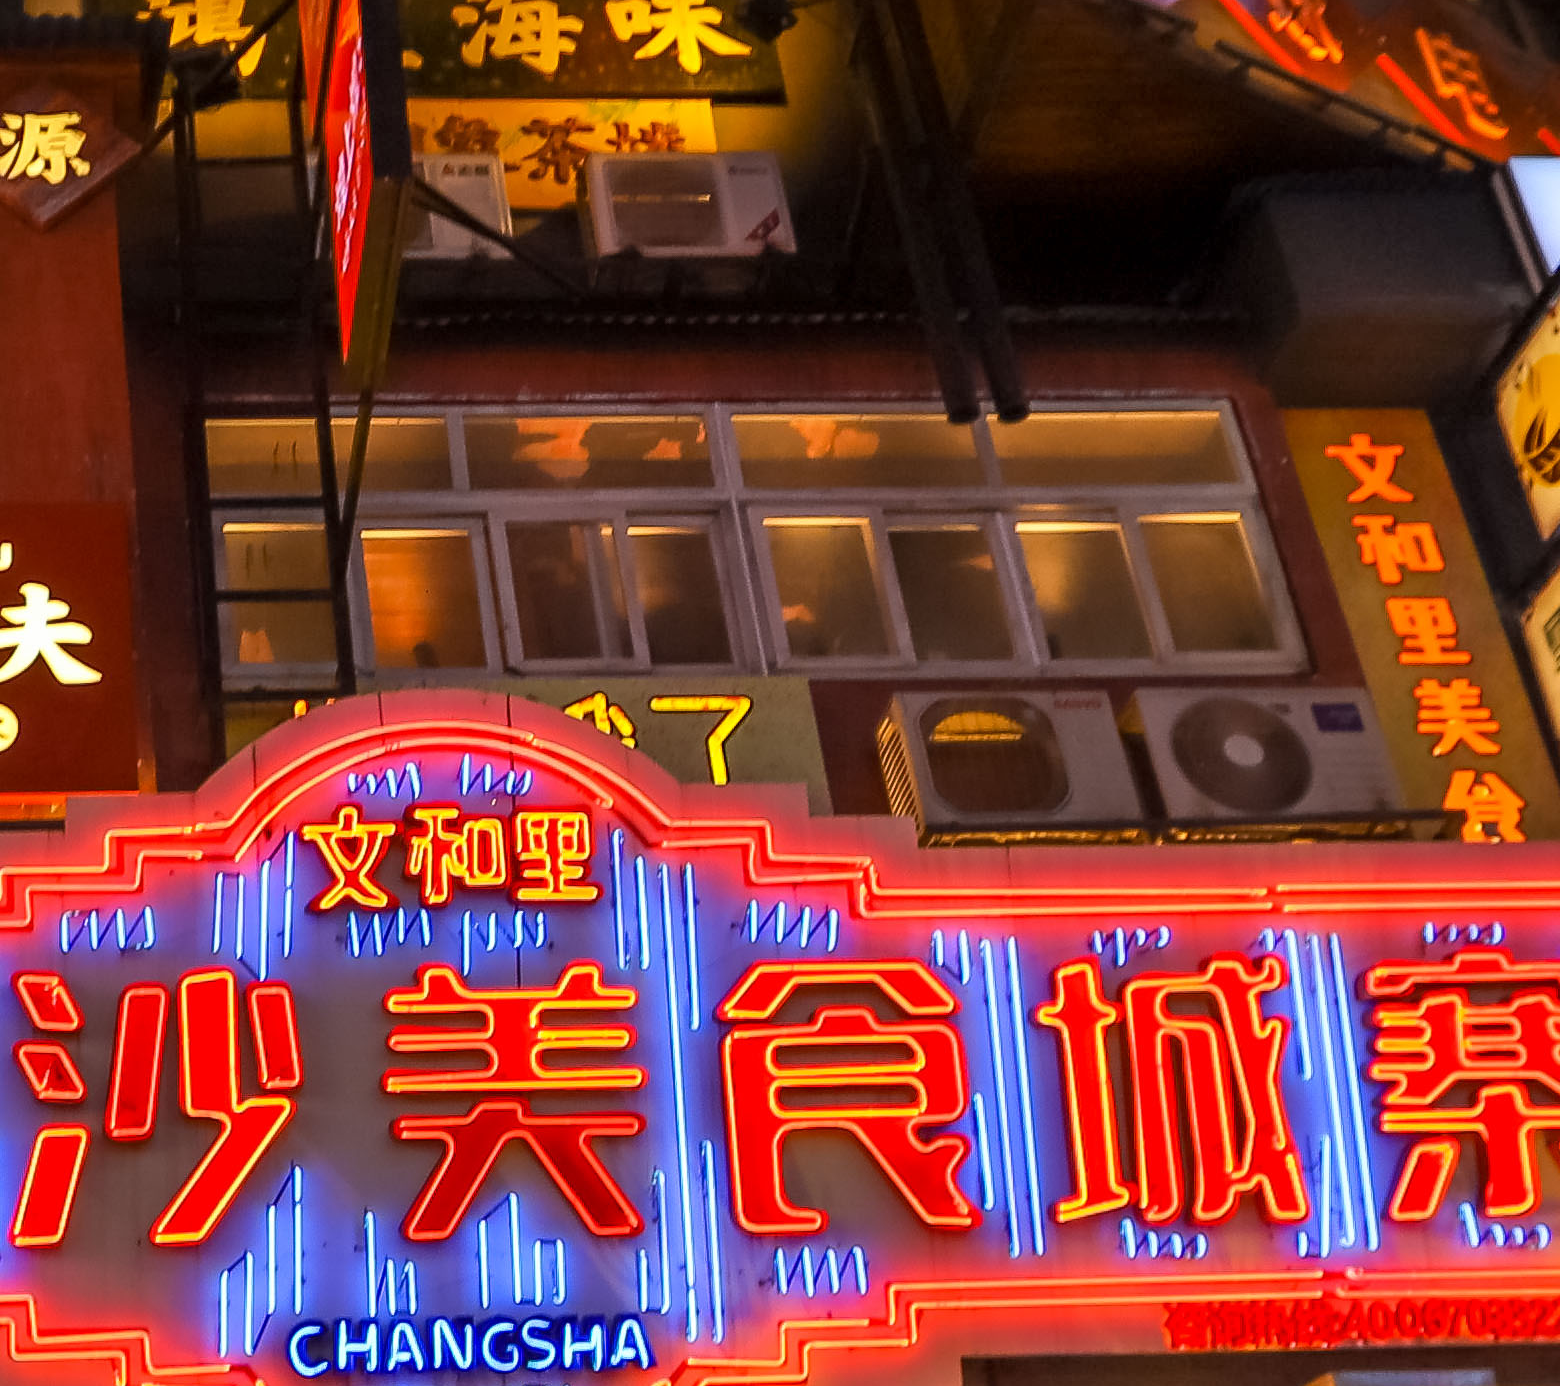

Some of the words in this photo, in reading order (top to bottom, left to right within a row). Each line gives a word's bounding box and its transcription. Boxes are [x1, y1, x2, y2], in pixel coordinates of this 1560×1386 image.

[301, 803, 599, 912] 文和里
[287, 1312, 652, 1381] CHANGSHA
